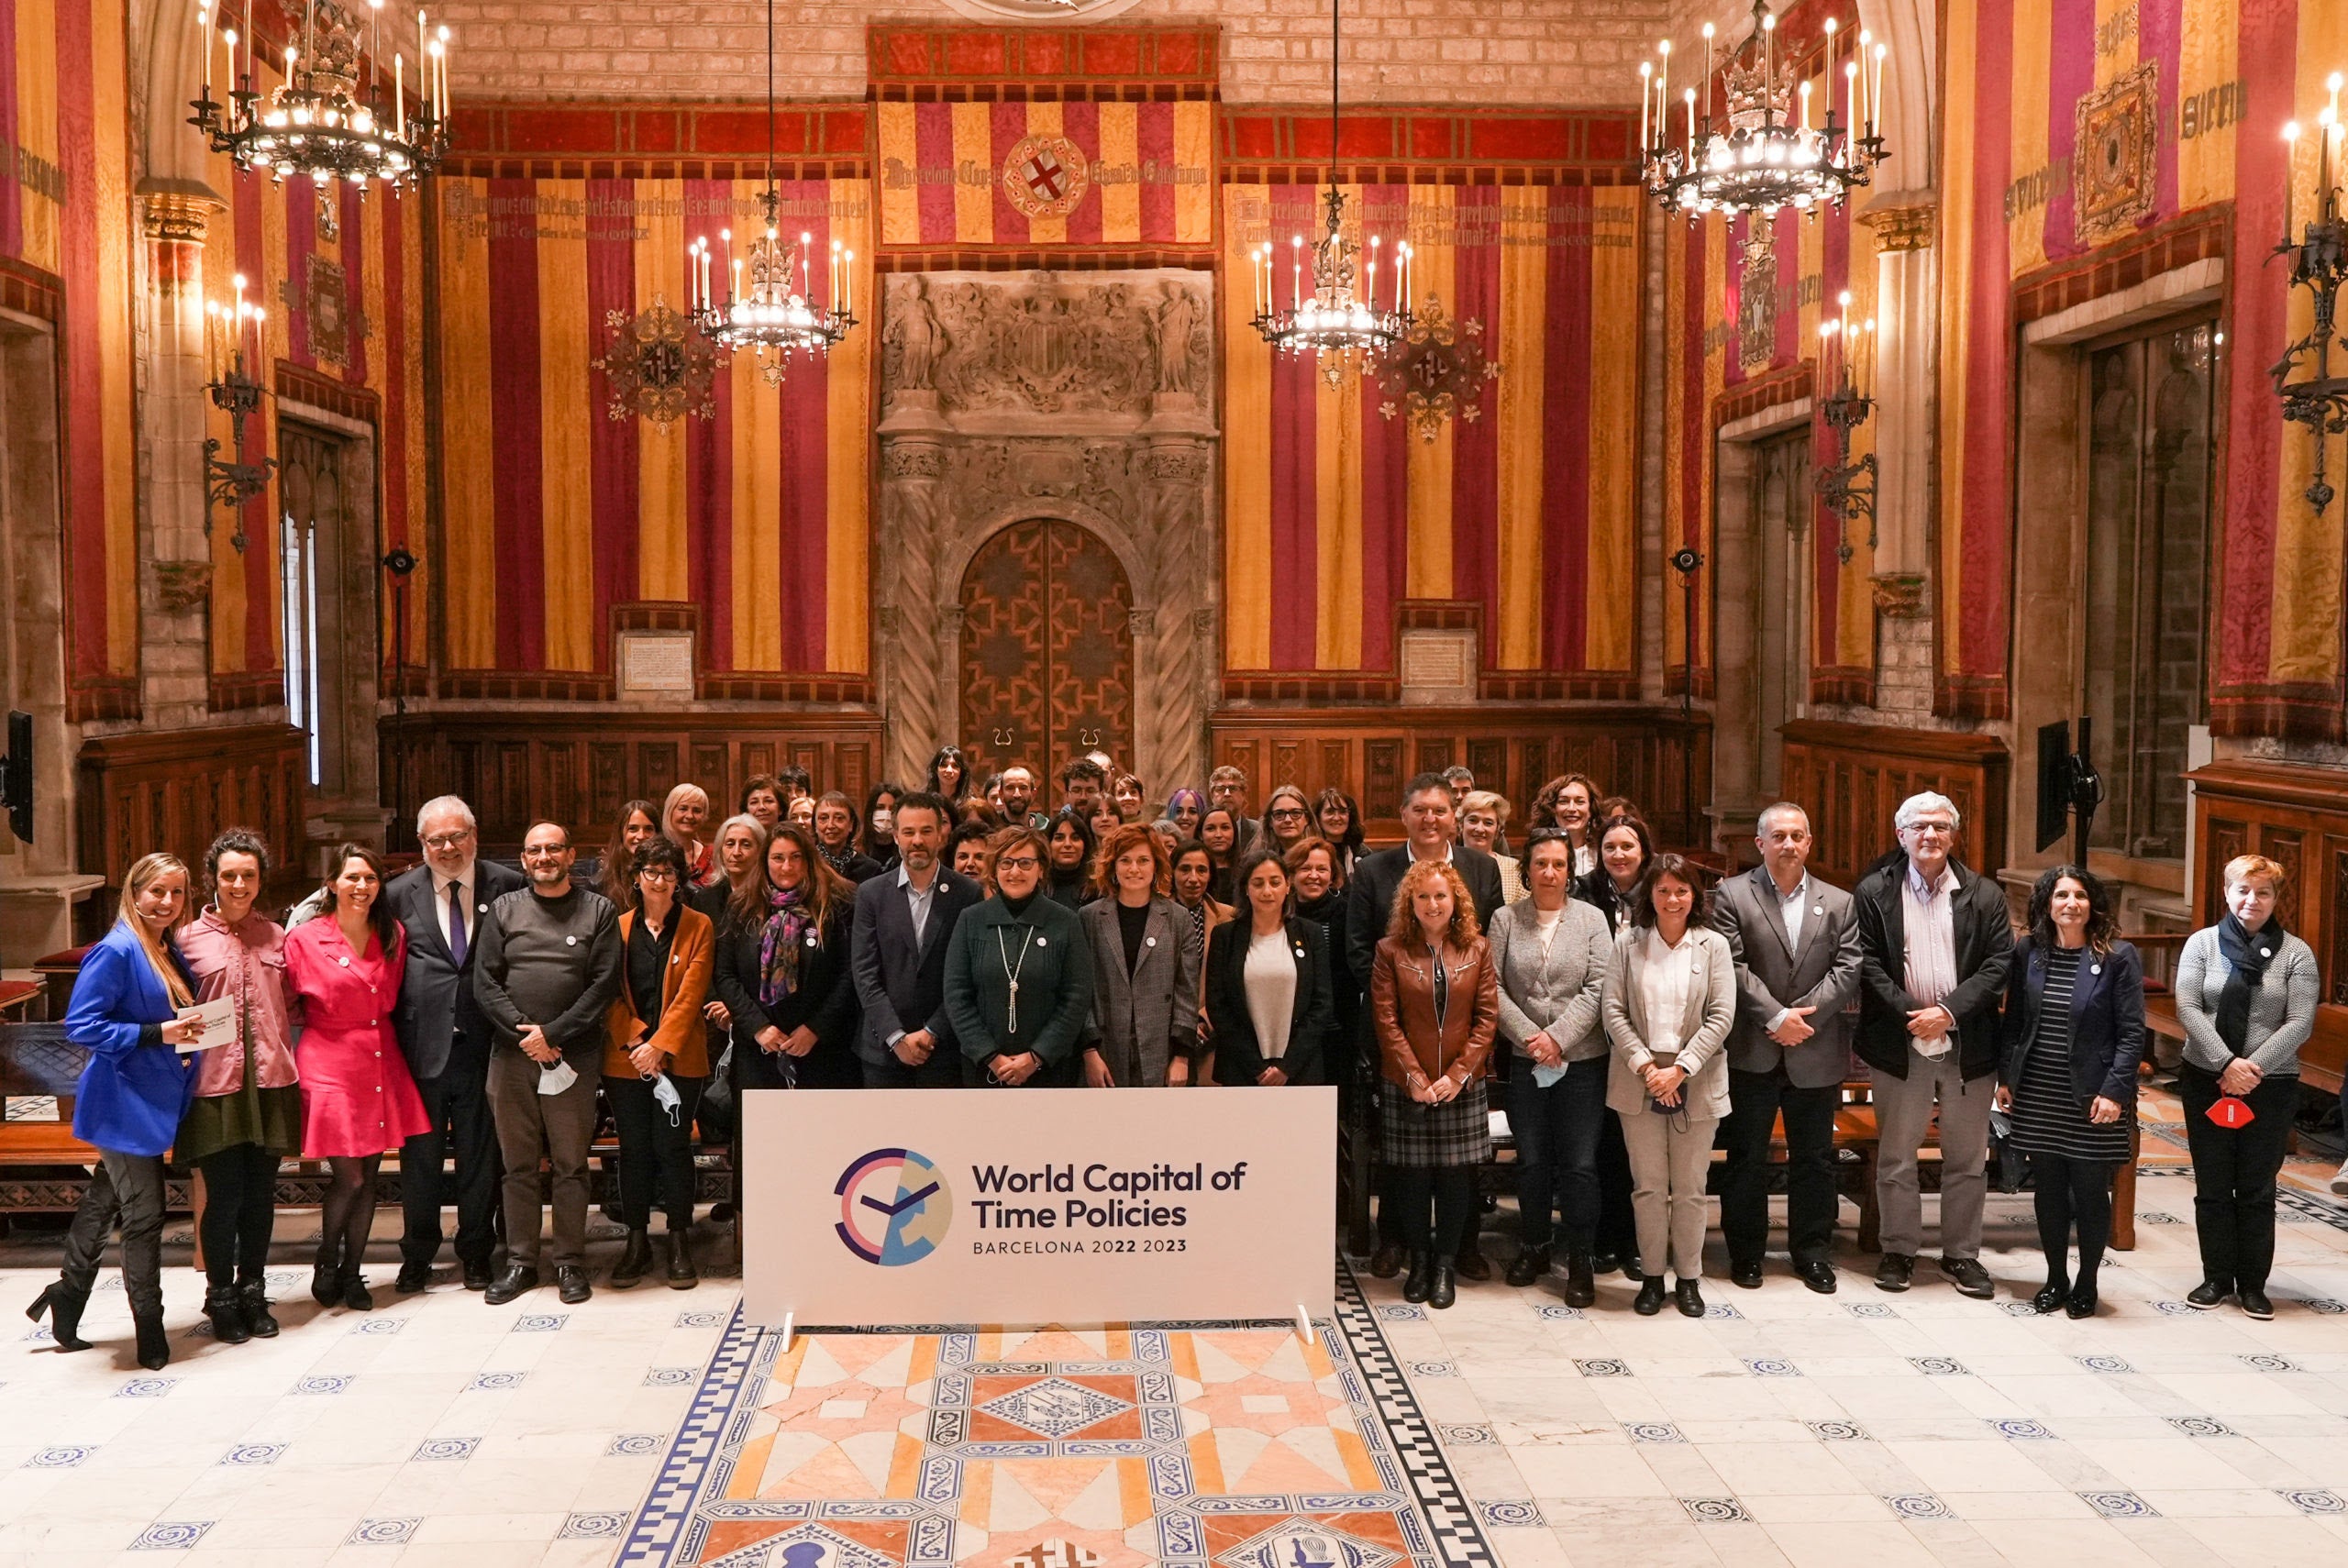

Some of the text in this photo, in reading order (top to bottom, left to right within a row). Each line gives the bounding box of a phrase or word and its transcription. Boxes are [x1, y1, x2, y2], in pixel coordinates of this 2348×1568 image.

[971, 1162, 1248, 1198] World Capital of
[971, 1198, 1187, 1228] Time Policies
[973, 1239, 1187, 1254] BARCELONA 2022 2023
